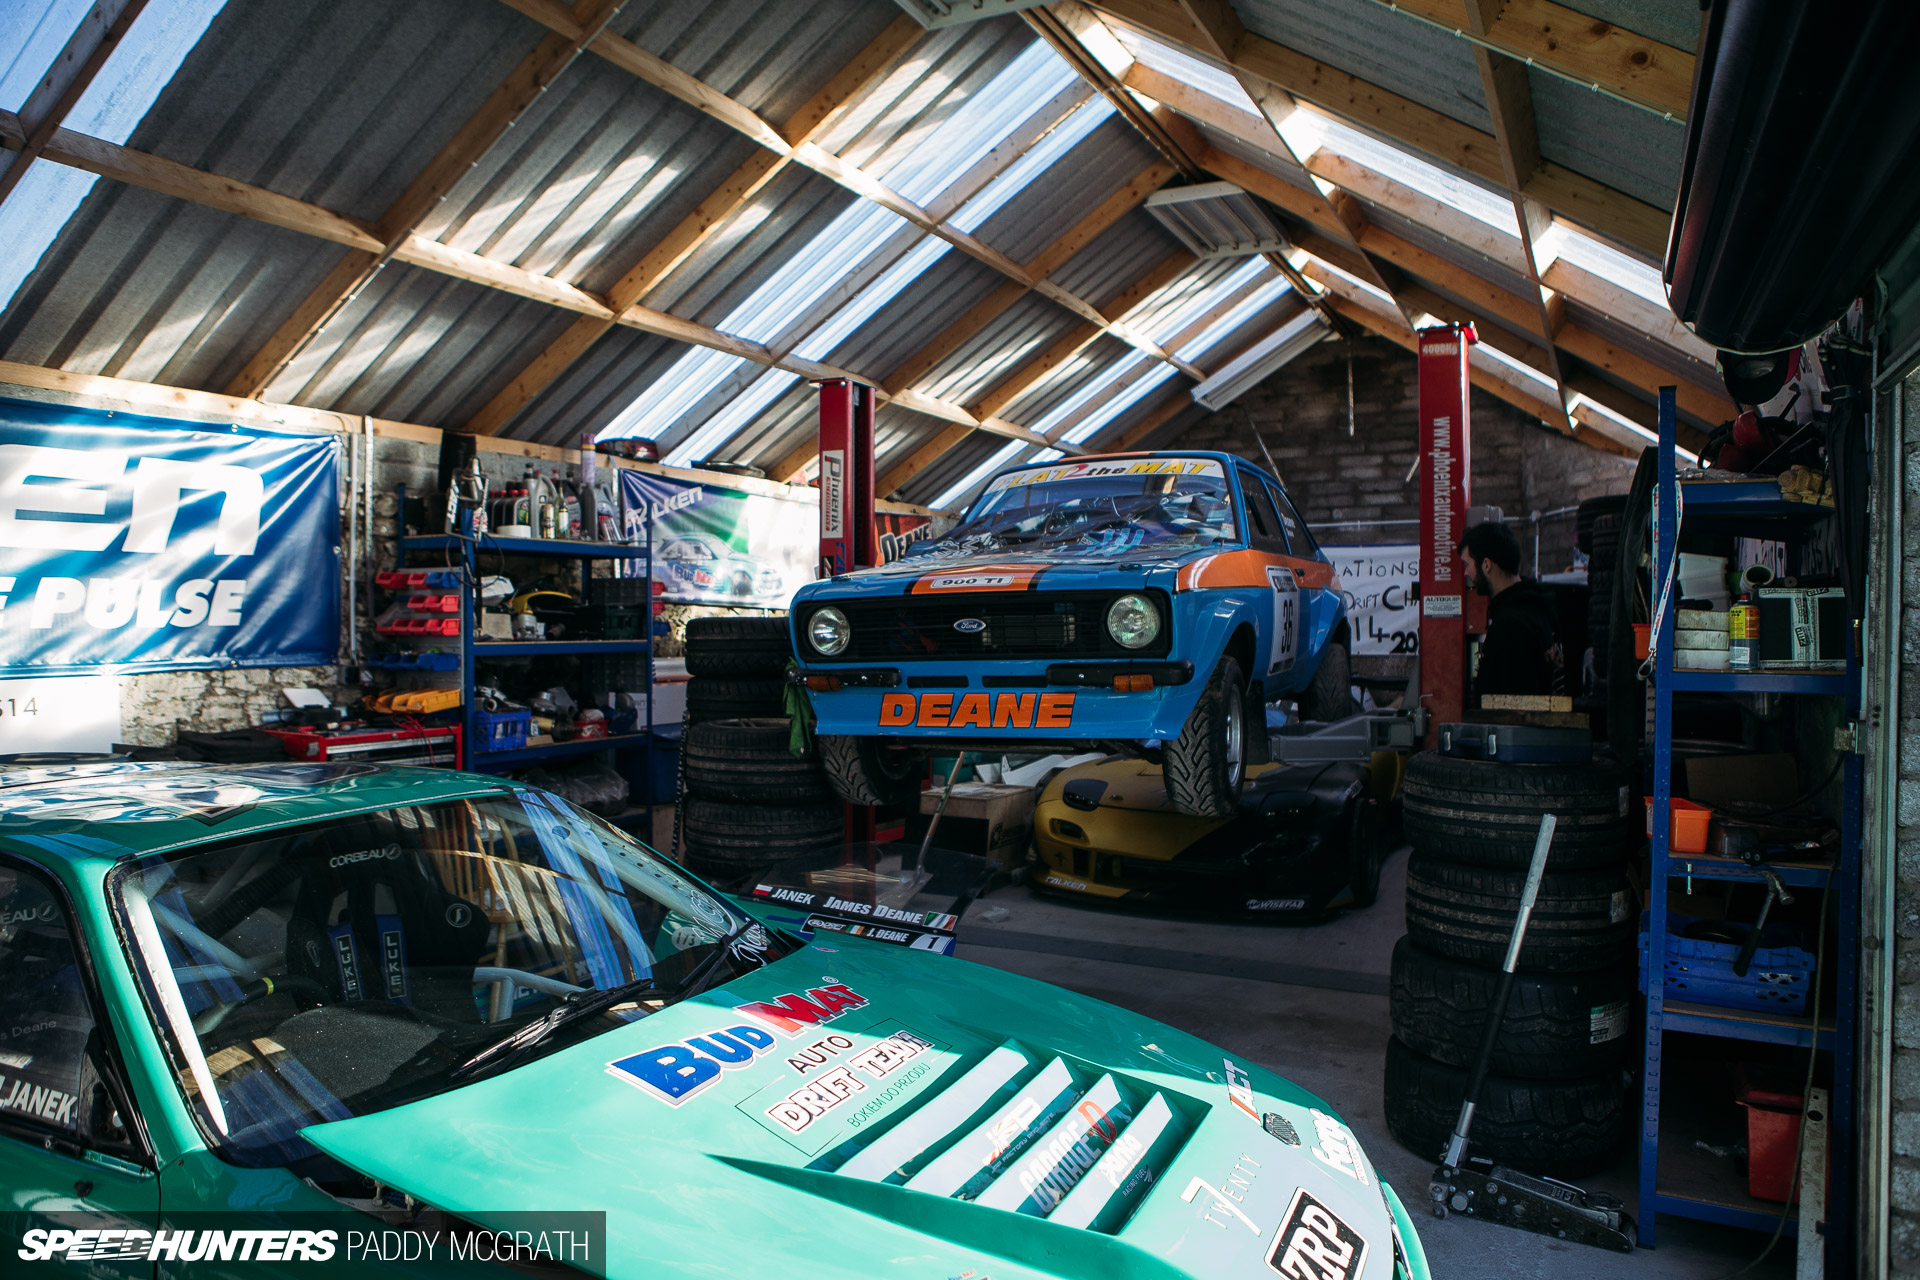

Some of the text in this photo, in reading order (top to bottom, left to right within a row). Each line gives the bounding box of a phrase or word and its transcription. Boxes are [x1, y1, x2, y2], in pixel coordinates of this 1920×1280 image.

[30, 577, 247, 629] PULSE
[880, 692, 1077, 729] DEANE
[329, 848, 386, 868] CORBEAU
[771, 888, 816, 905] JANEK
[876, 928, 910, 943] DEANE
[338, 940, 357, 991] LUKE
[386, 935, 402, 986] LUKE
[788, 1034, 855, 1074] AUTO
[5, 1079, 78, 1124] JANEK
[767, 1031, 935, 1132] DRIFT TEAM
[846, 1094, 887, 1130] BOKIEM
[892, 1059, 931, 1092] PRZODU
[1120, 1177, 1138, 1197] RACING
[1134, 1167, 1146, 1180] FUEL
